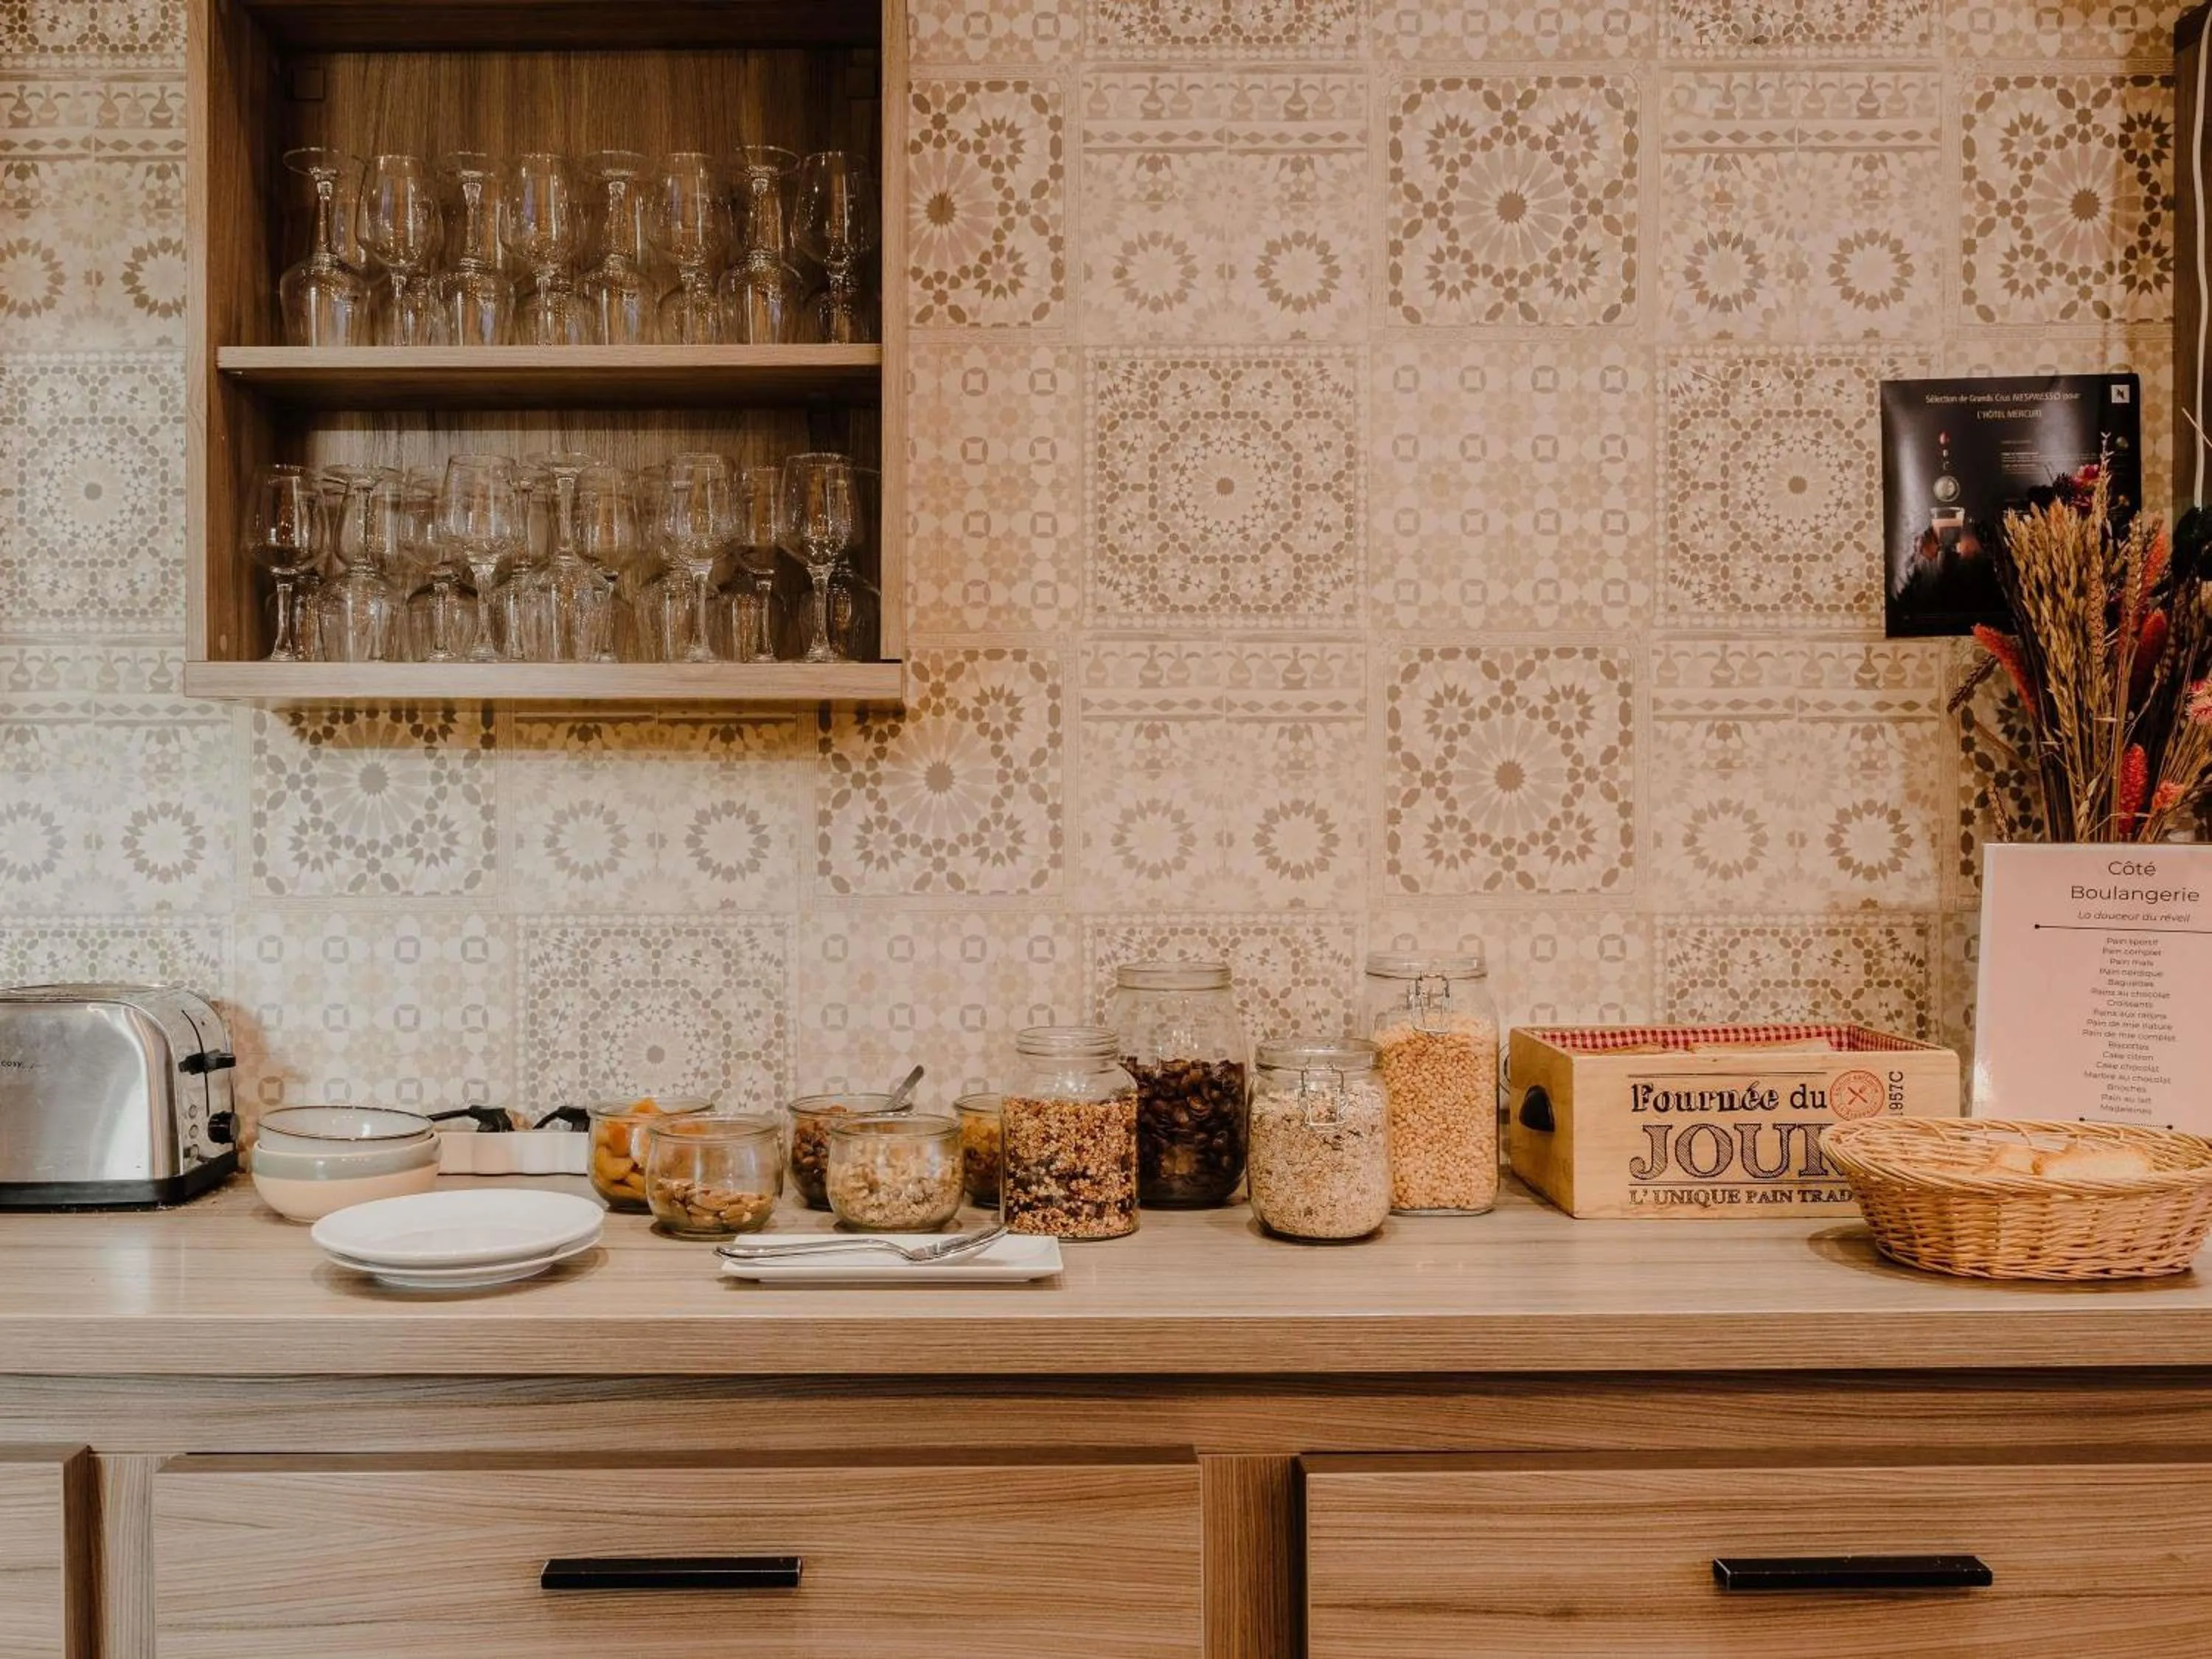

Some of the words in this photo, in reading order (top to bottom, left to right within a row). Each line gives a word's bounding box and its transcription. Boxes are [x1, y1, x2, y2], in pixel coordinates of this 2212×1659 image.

[2012, 391, 2061, 402] NESPRESSO
[2007, 409, 2042, 419] MERCURE
[2108, 860, 2157, 877] Côté
[2071, 886, 2199, 905] Boulangerie
[2077, 911, 2090, 920] La
[2093, 911, 2140, 921] douceur
[2142, 911, 2157, 921] du
[2160, 911, 2191, 922] réveil
[2102, 946, 2121, 955] Pain
[2124, 948, 2161, 956] complet
[2110, 958, 2130, 966] Pain
[2129, 990, 2171, 999] chocolat
[2107, 999, 2153, 1009] Croissants
[2087, 1018, 2107, 1027] Pain
[2081, 1029, 2102, 1037] Pain
[2102, 1051, 2124, 1060] Cake
[2126, 1052, 2154, 1061] citron
[2096, 1061, 2118, 1070] Cake
[2120, 1063, 2160, 1073] chocolat
[2132, 1075, 2171, 1085] chocolat
[1631, 1080, 1779, 1113] Fournée
[1790, 1083, 1828, 1110] du
[1888, 1071, 1904, 1116] 1957C
[2101, 1093, 2121, 1102] Pain
[1653, 1188, 1740, 1208] UNIQUE
[1745, 1189, 1792, 1204] PAIN
